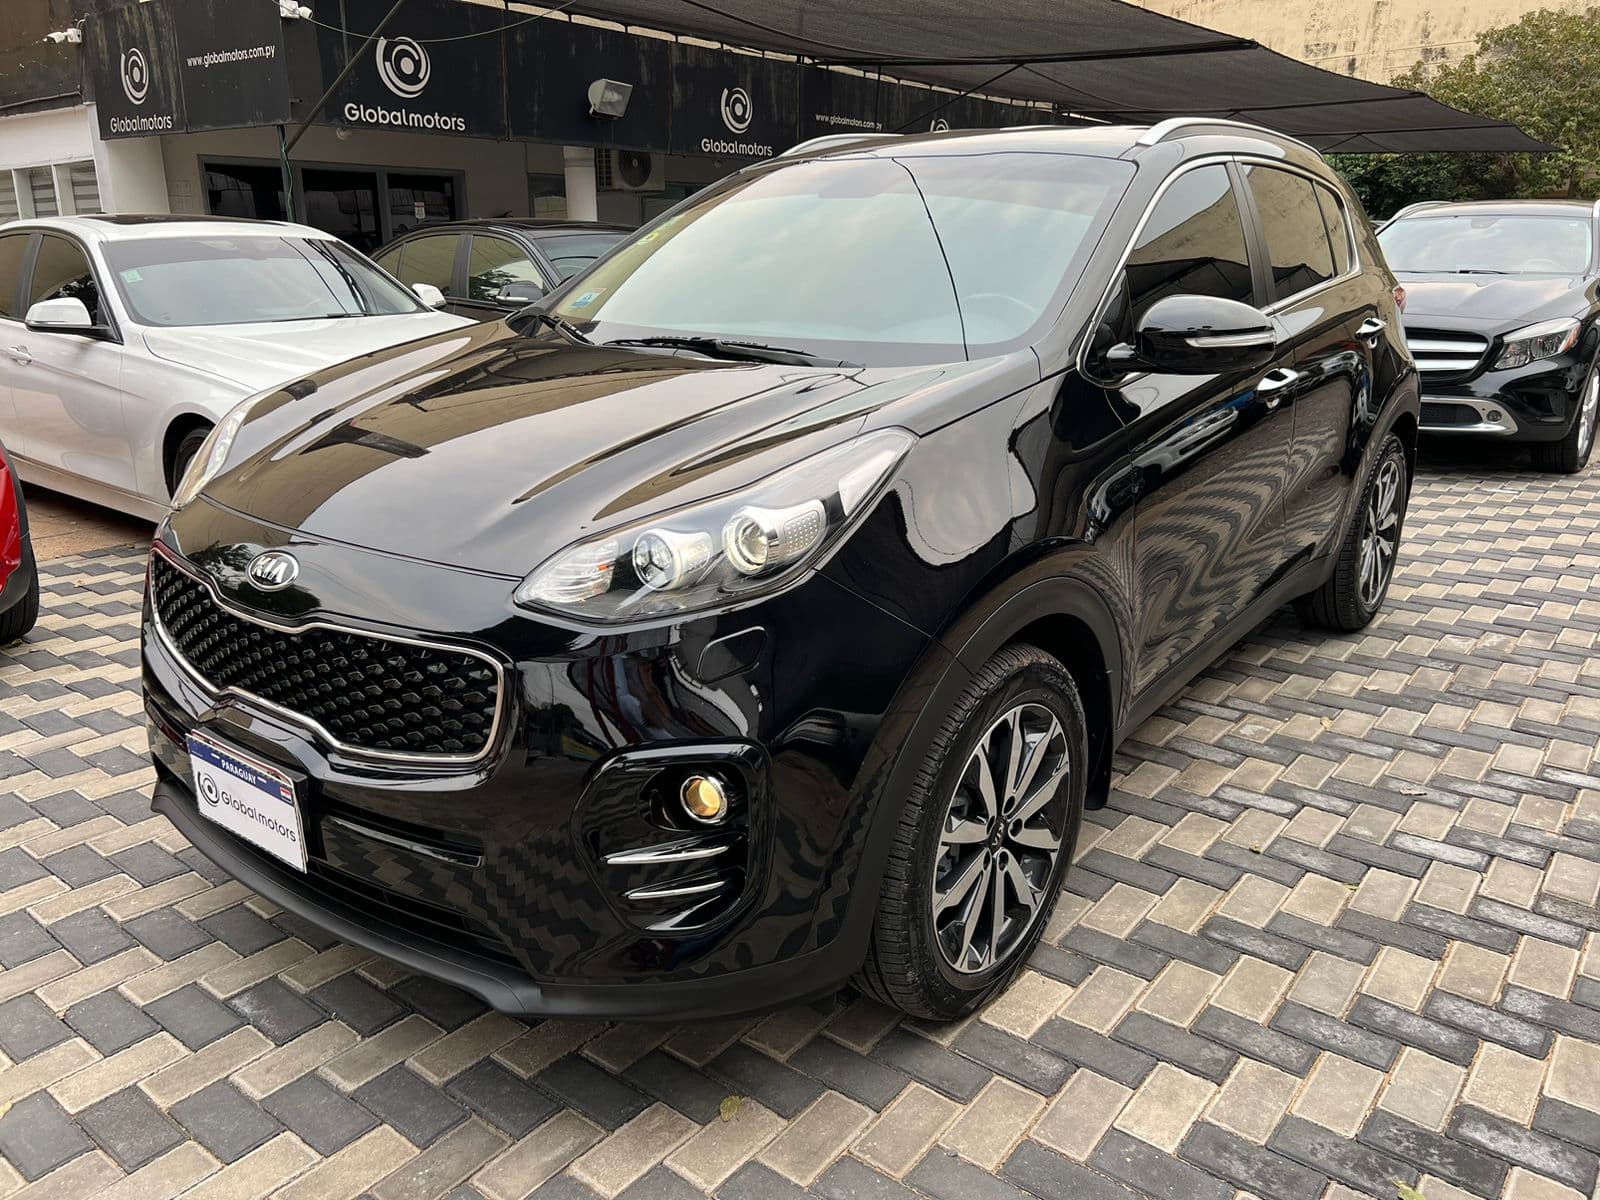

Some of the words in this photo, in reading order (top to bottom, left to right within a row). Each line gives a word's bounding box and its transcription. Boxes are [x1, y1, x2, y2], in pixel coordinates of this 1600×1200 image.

[186, 45, 275, 68] www.globalmotors.com.py
[110, 114, 172, 132] Globalmotors
[344, 103, 466, 131] Globalmotors
[815, 114, 882, 131] www.globalmotors.compy
[701, 138, 773, 156] Globalmotors
[252, 556, 288, 583] KIA
[221, 759, 256, 784] PARAGUAY
[221, 790, 297, 842] Globalmotors
